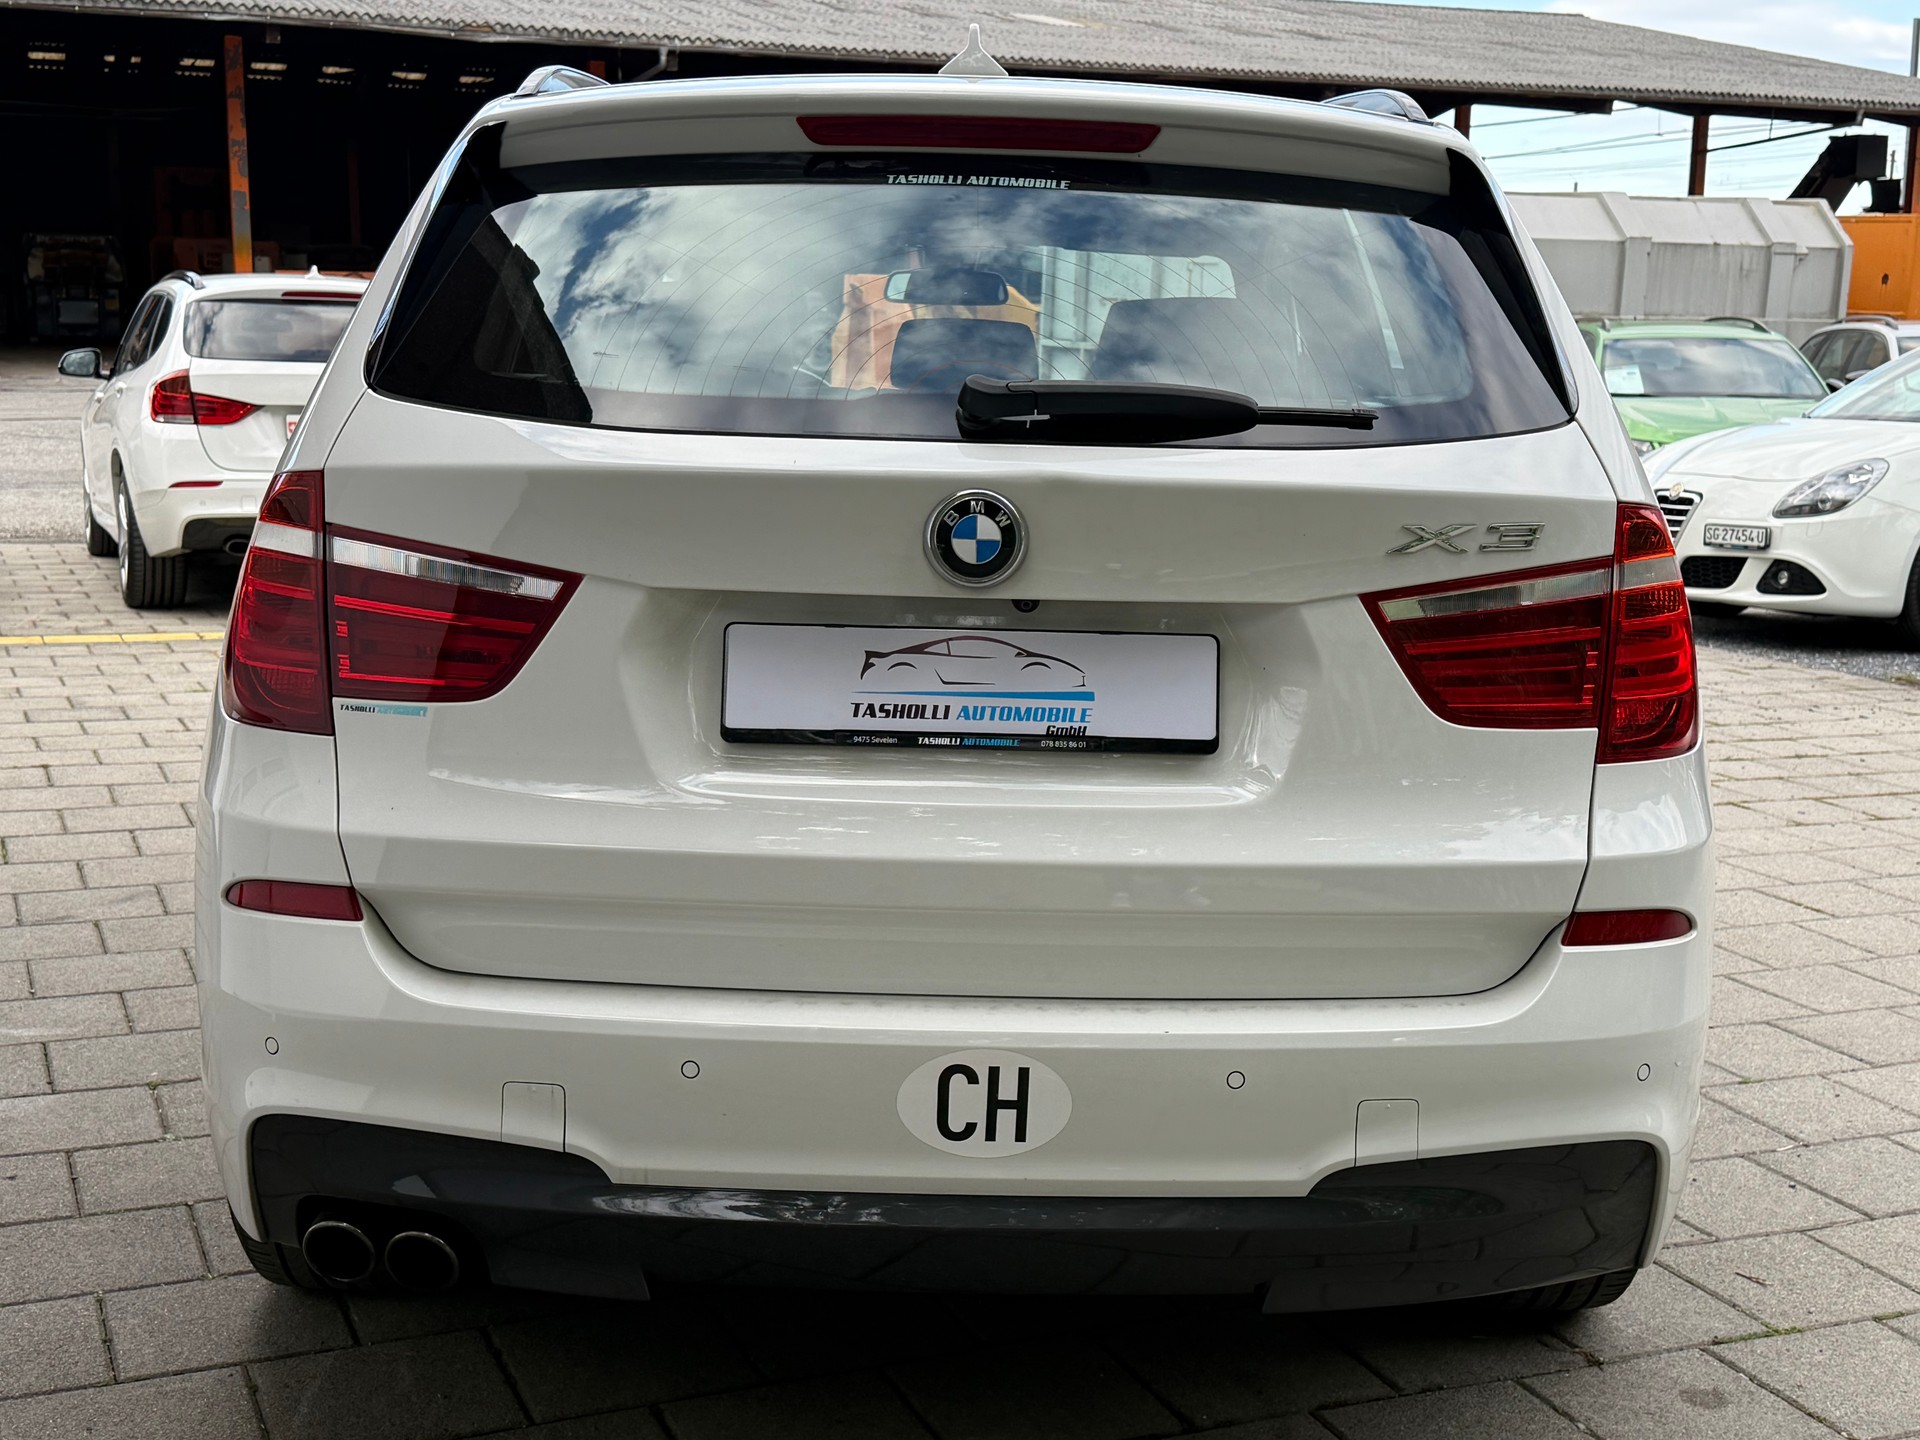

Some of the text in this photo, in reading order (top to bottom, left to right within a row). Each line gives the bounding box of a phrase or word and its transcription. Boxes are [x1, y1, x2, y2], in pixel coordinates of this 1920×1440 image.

[886, 174, 1071, 190] TASHOLLI AUTOMOBILE
[943, 500, 1011, 528] BMW
[1384, 521, 1546, 554] X3
[1706, 527, 1720, 541] SG
[850, 702, 1093, 723] TASHOLLI AUTOMOBILE
[1045, 725, 1088, 736] GmbH
[853, 735, 898, 744] 9475 Sevelen
[917, 736, 1020, 747] TASHOLLI AUTOMOBILE
[1040, 740, 1054, 748] 078
[1054, 740, 1068, 748] 835
[936, 1063, 1031, 1143] CH
